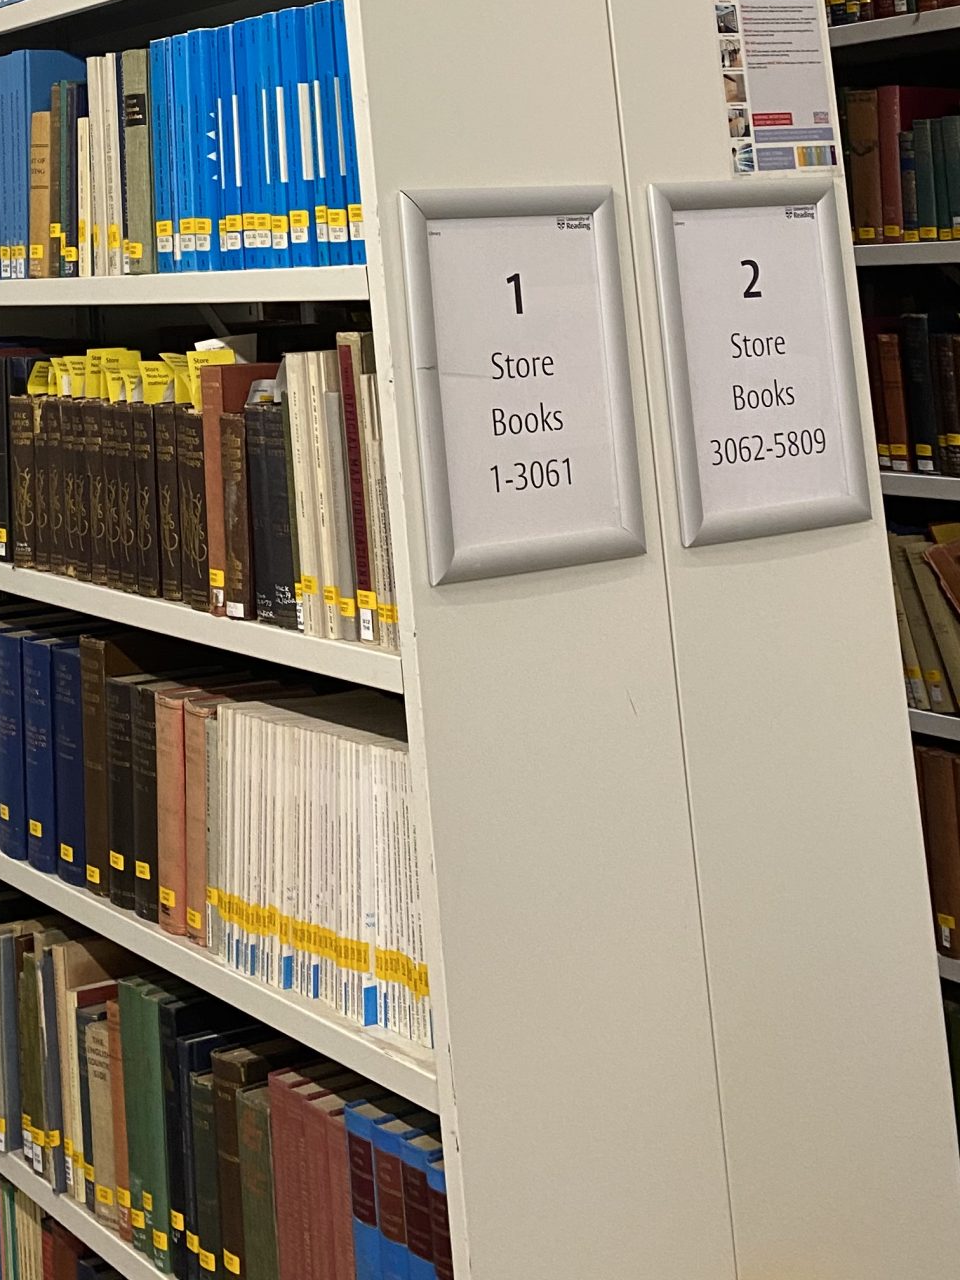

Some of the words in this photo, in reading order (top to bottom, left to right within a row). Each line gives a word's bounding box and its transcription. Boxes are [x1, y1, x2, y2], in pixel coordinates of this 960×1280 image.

[566, 221, 591, 231] Reading
[793, 211, 815, 220] Reading
[506, 273, 524, 315] 1
[740, 259, 762, 299] 2
[730, 332, 786, 359] Store
[491, 351, 555, 380] Store
[732, 378, 795, 411] Books
[344, 393, 357, 450] OFFICIAL
[492, 402, 564, 436] Books
[710, 427, 827, 466] 3062-5809
[350, 458, 360, 485] MAP
[490, 457, 572, 493] 1-3061
[352, 491, 368, 586] PUBLICATIONS
